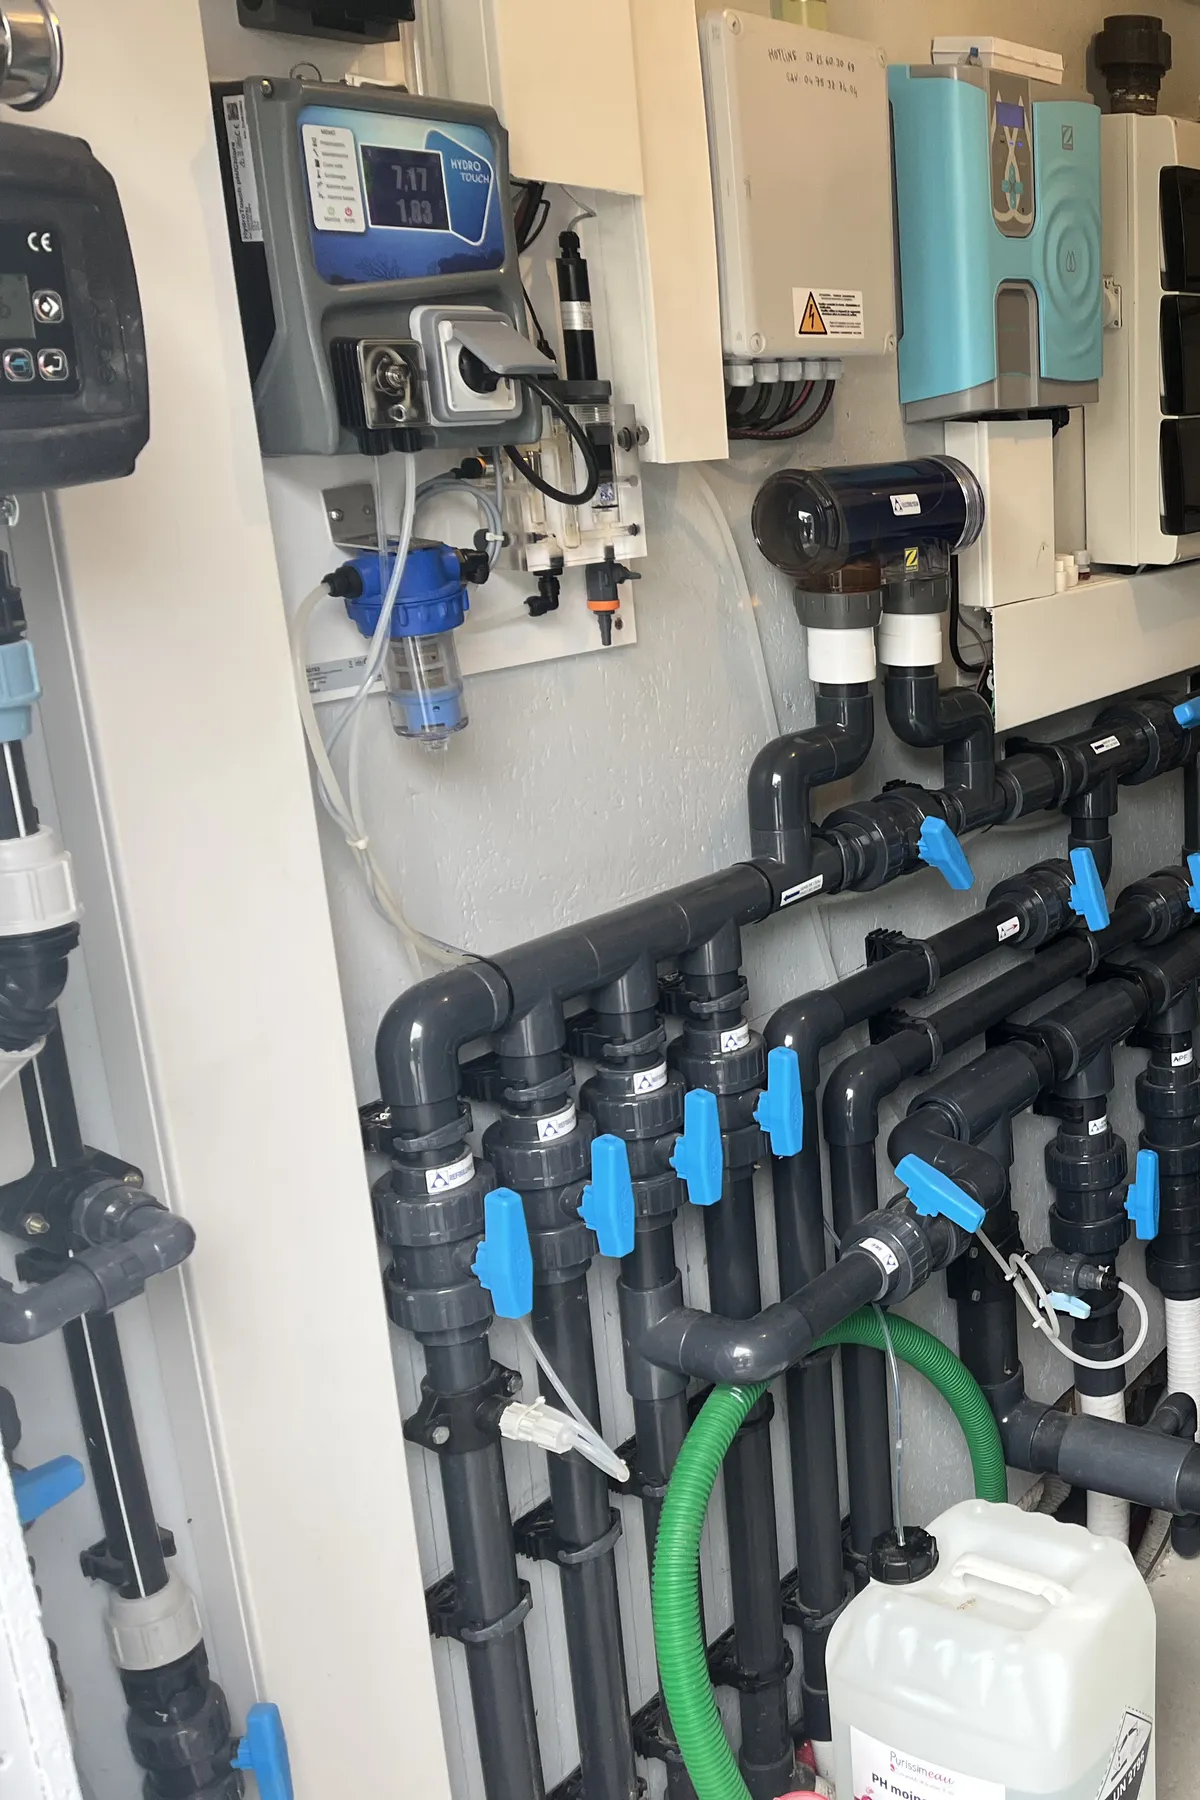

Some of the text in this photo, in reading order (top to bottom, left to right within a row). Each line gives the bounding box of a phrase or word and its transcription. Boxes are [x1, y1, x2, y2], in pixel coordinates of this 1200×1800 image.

[450, 157, 482, 172] HYDRO
[459, 172, 490, 184] TOUCH
[889, 1750, 955, 1785] Purissimeau
[1112, 1750, 1145, 1800] UN 2796
[871, 1771, 888, 1790] PH
[890, 1783, 927, 1800] moin
